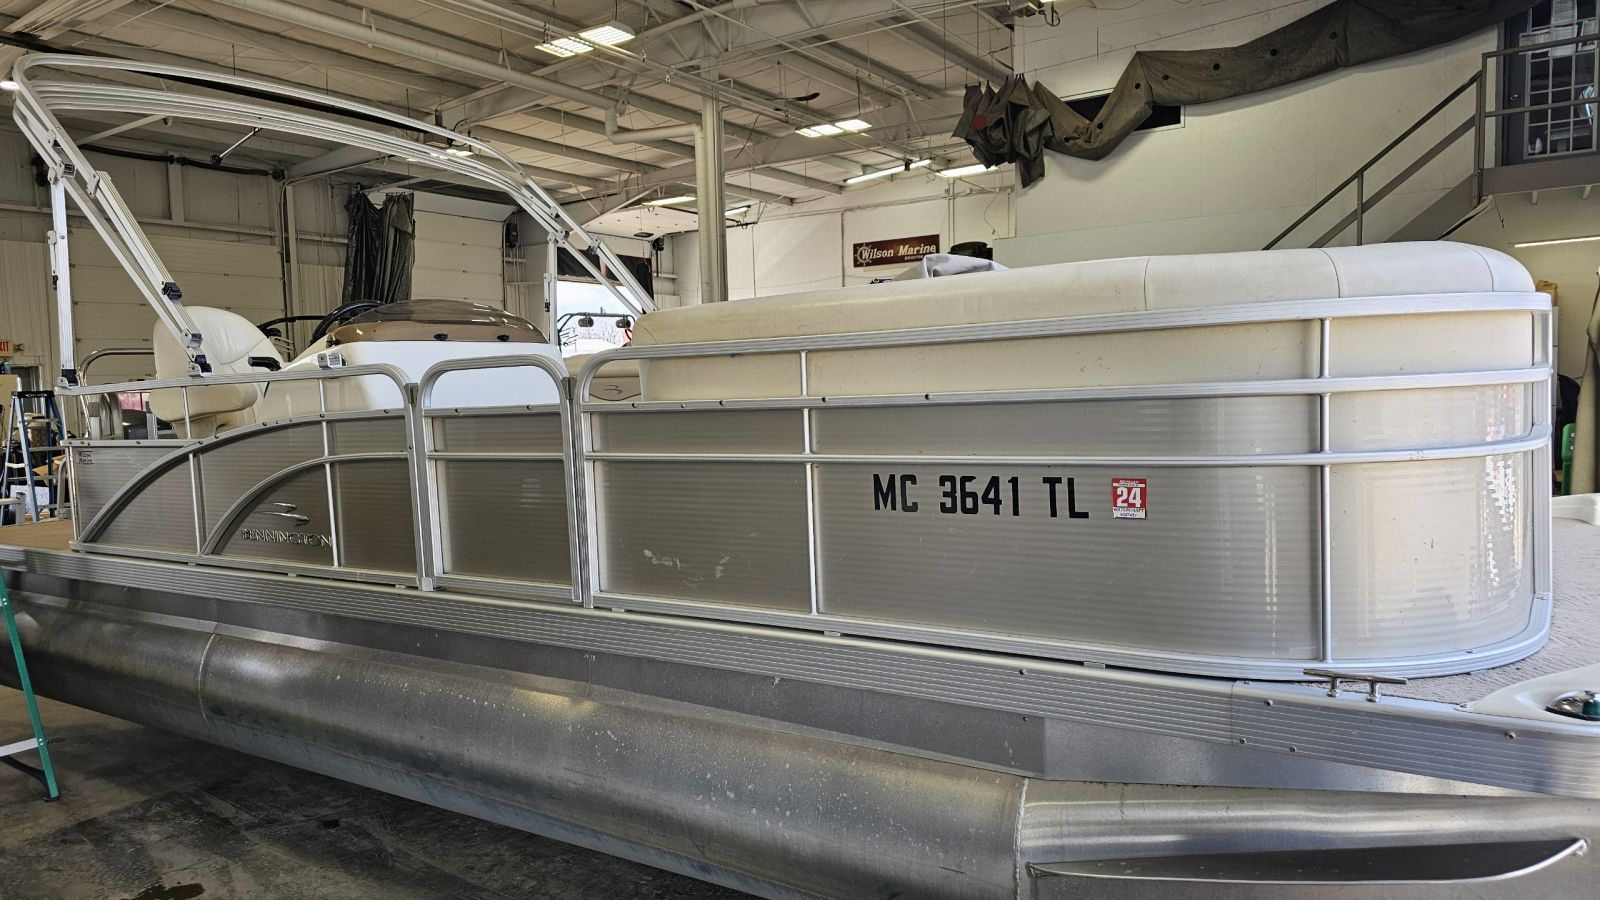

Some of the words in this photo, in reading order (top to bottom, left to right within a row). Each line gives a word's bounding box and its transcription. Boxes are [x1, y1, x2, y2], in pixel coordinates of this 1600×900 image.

[861, 248, 894, 260] Wilson
[898, 244, 936, 256] Marine
[872, 473, 919, 513] MC
[938, 474, 1020, 517] 3641
[1042, 476, 1090, 519] TL
[1116, 487, 1141, 508] 24
